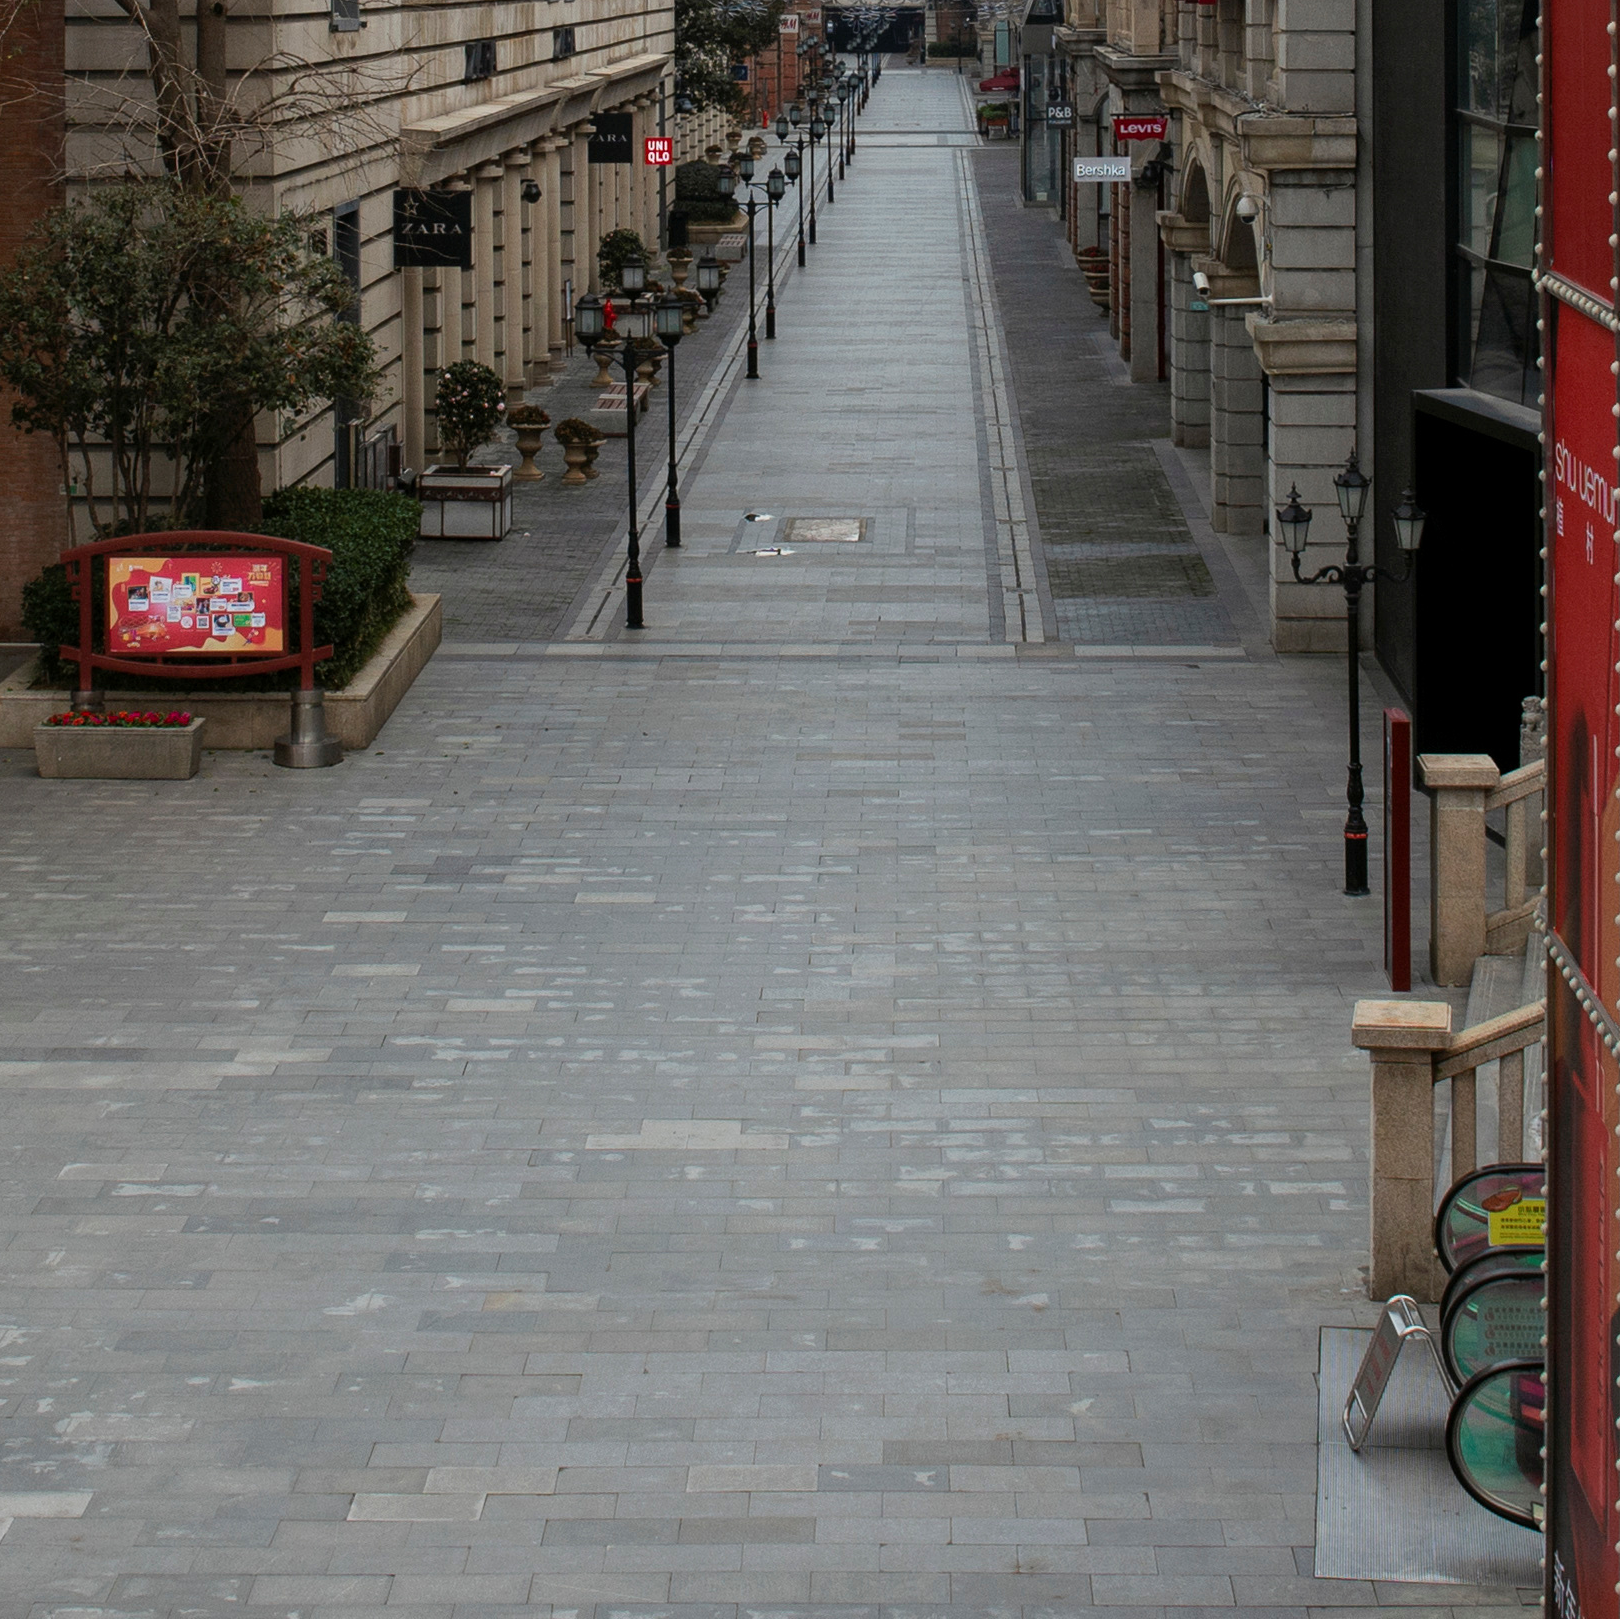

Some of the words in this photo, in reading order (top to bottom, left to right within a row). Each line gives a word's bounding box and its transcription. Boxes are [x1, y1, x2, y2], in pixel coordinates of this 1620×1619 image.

[1048, 106, 1072, 118] P&B
[647, 141, 668, 151] UNI
[647, 151, 670, 163] QLO
[1076, 164, 1126, 177] Bershka
[401, 223, 463, 235] ZARA
[1556, 438, 1577, 493] shu
